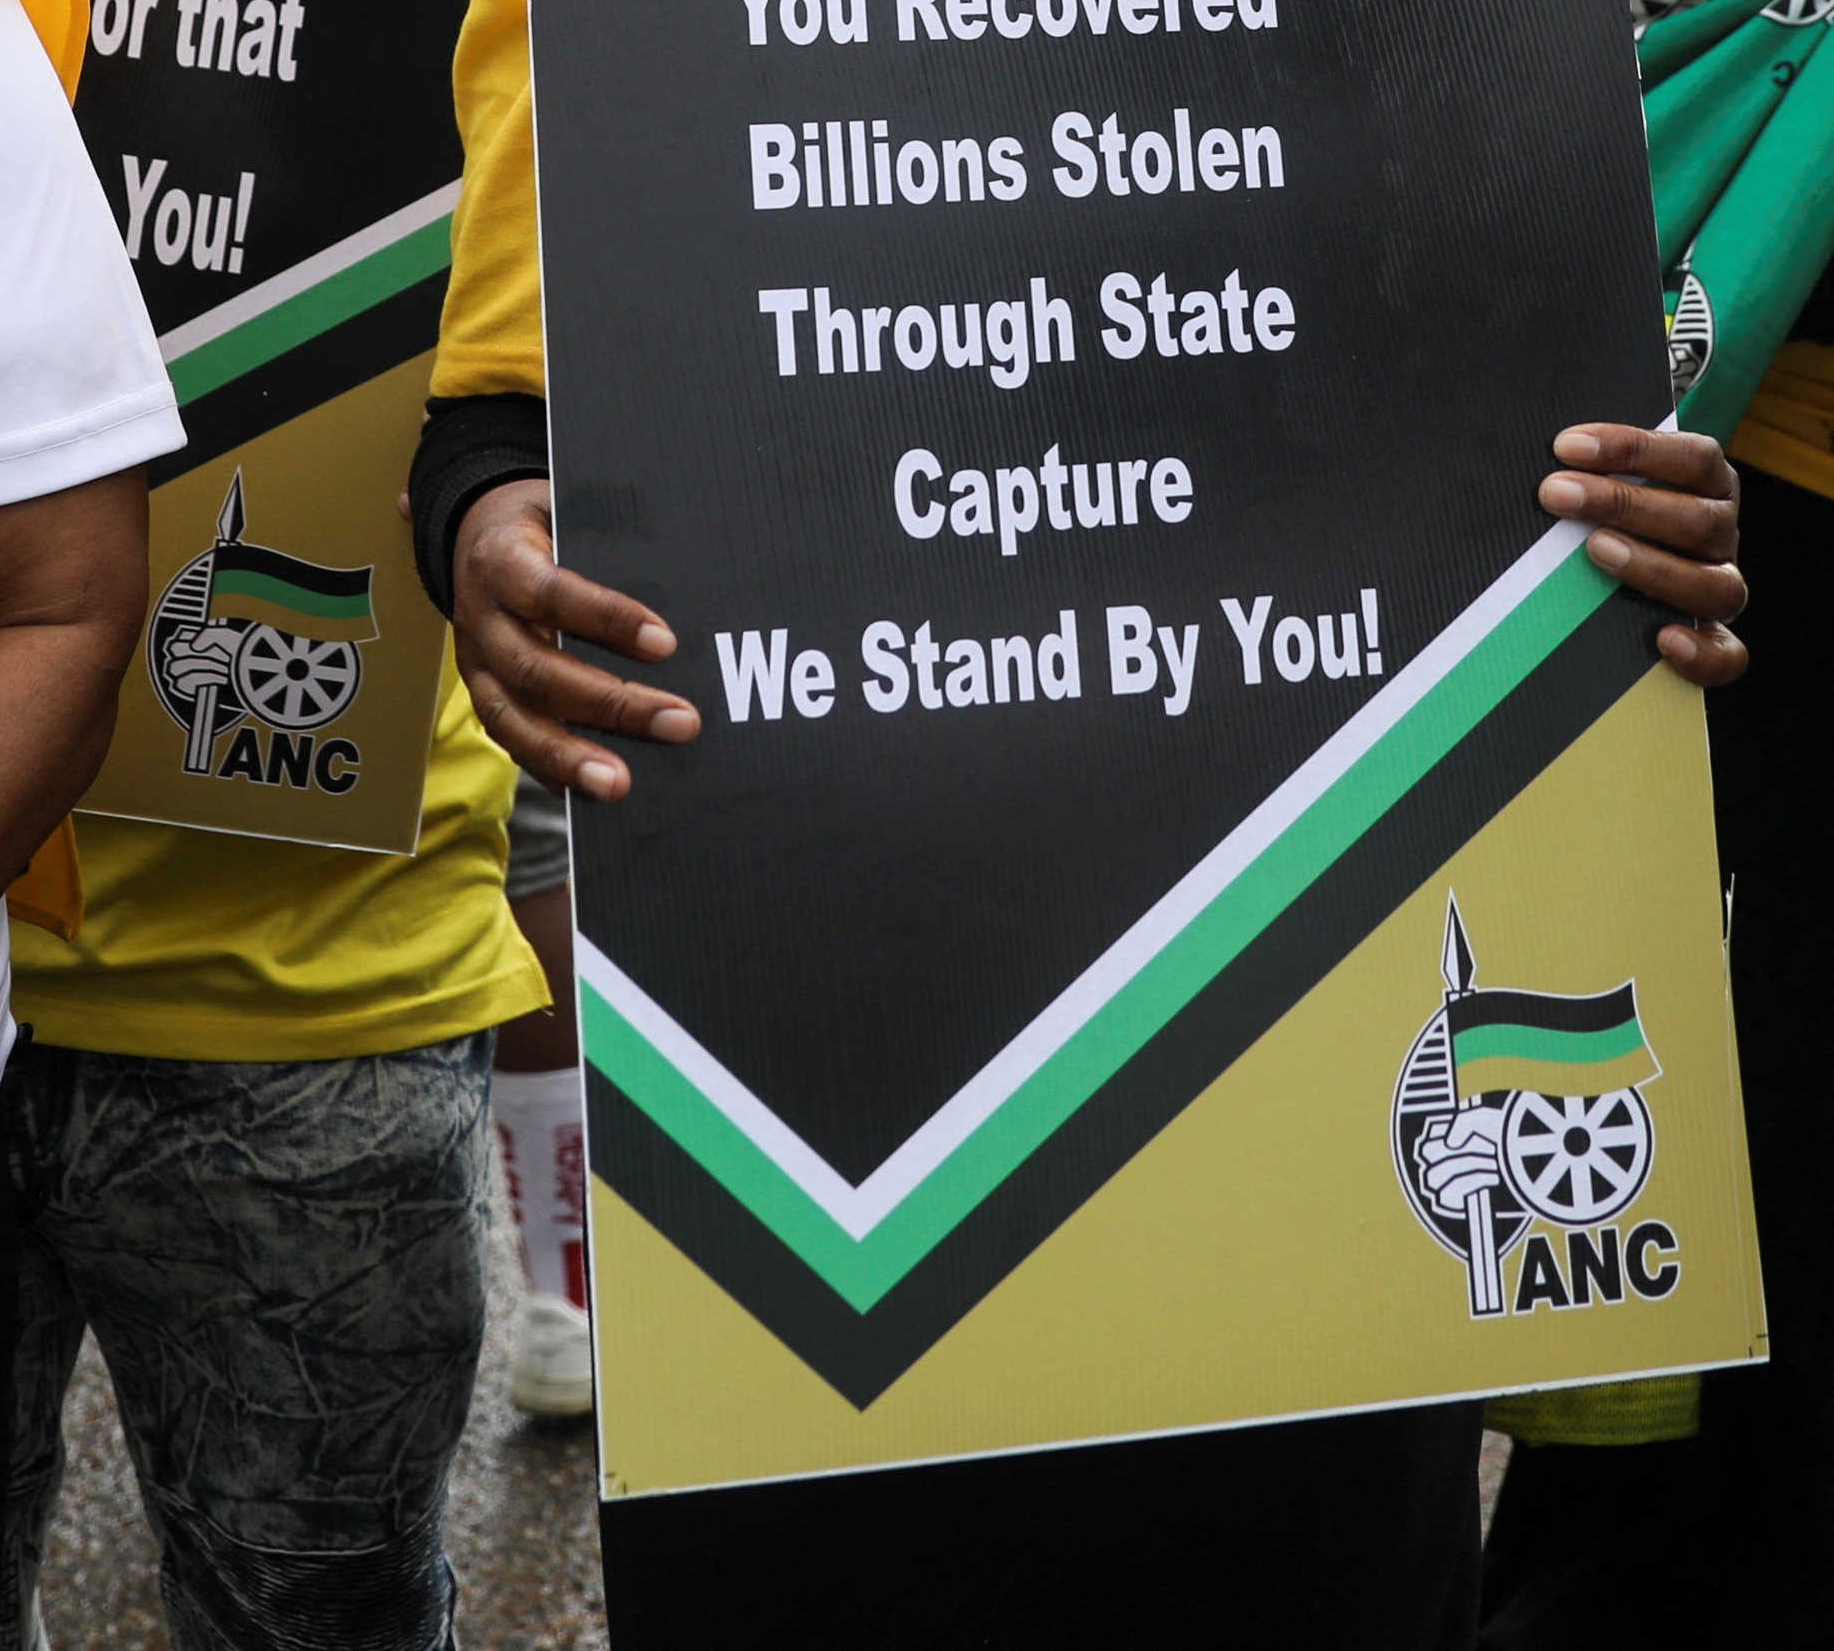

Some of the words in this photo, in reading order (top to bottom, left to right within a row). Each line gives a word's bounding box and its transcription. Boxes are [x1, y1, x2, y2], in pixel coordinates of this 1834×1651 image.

[122, 154, 255, 274] You!
[750, 120, 1027, 209] Billions
[1052, 109, 1284, 197] Stolen
[759, 278, 1075, 389] Through
[1101, 269, 1295, 359] State
[895, 443, 1192, 555] Capture
[715, 629, 835, 722] We
[862, 610, 1081, 712] Stand
[1106, 606, 1199, 715] By
[1220, 589, 1382, 684] You!
[219, 727, 359, 793] ANC
[1514, 1222, 1679, 1312] ANC
